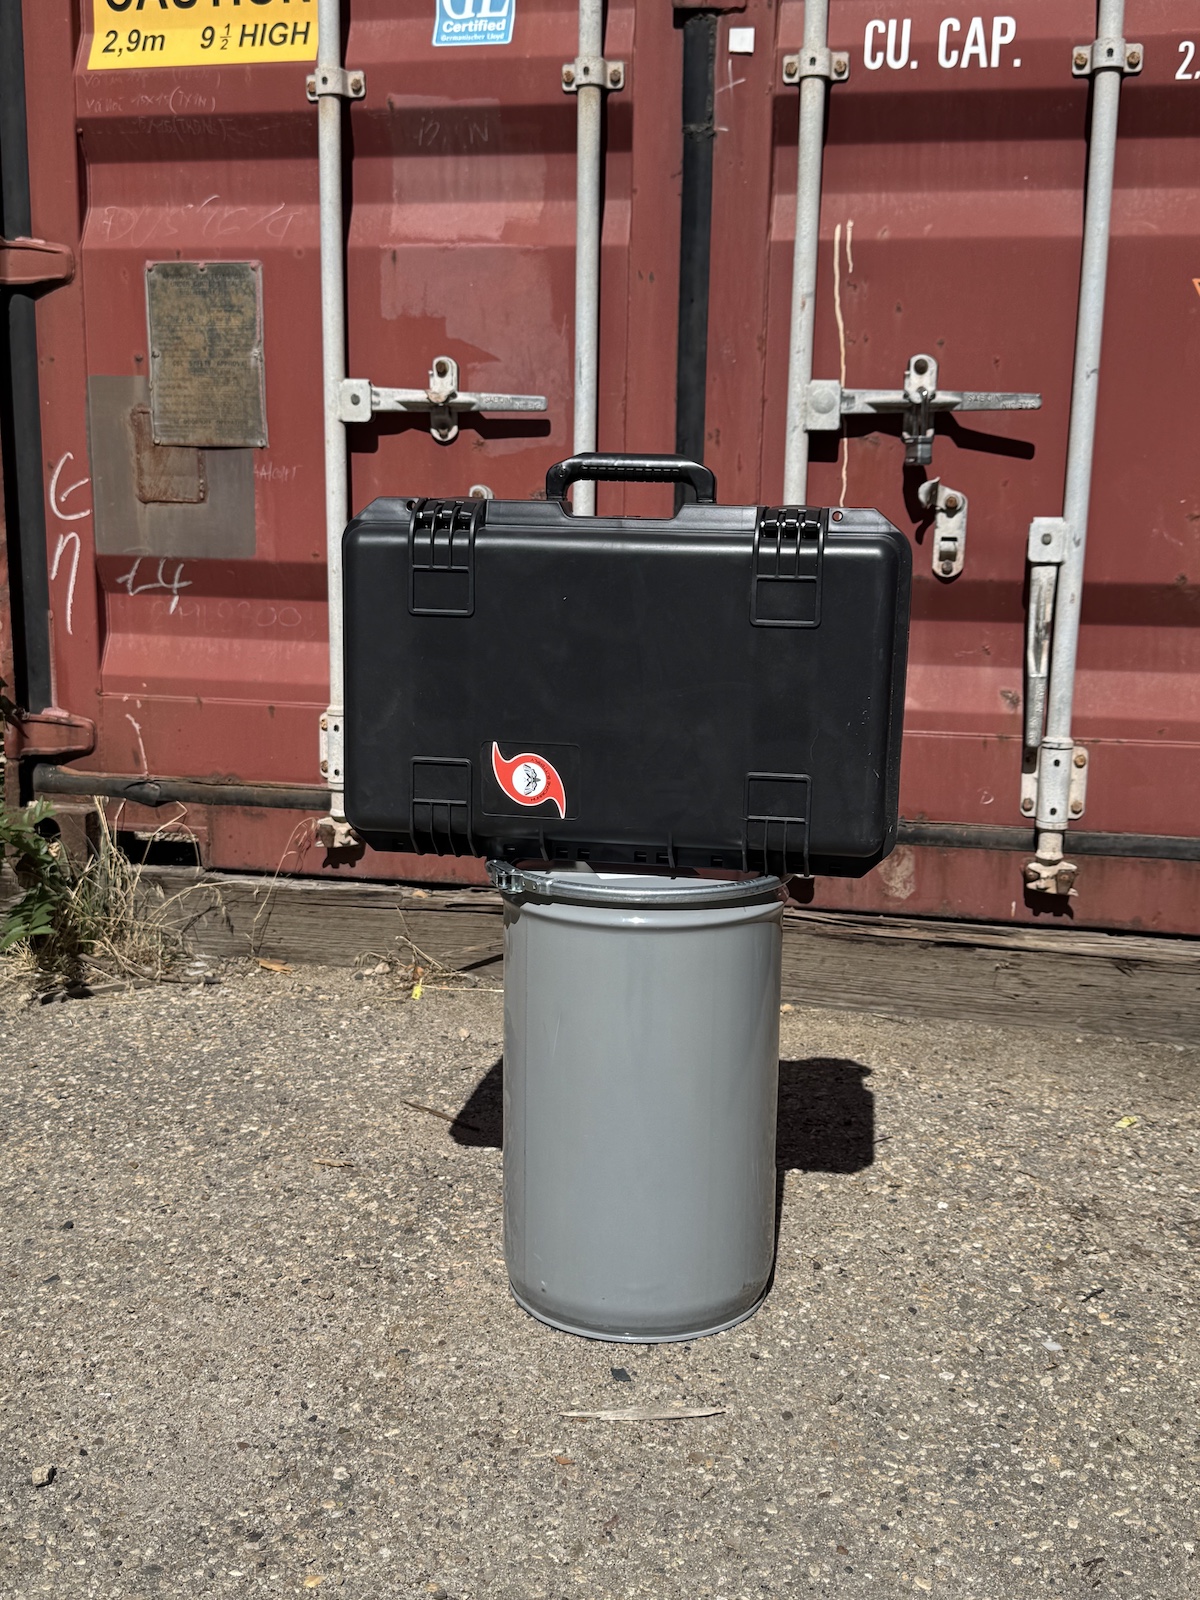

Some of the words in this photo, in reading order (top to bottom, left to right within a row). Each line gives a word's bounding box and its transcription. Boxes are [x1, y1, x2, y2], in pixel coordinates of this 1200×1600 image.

[102, 29, 166, 57] 2,9m
[238, 21, 311, 47] HIGH
[442, 18, 507, 33] Certified
[863, 18, 918, 70] CU.
[937, 16, 1022, 69] CAP.
